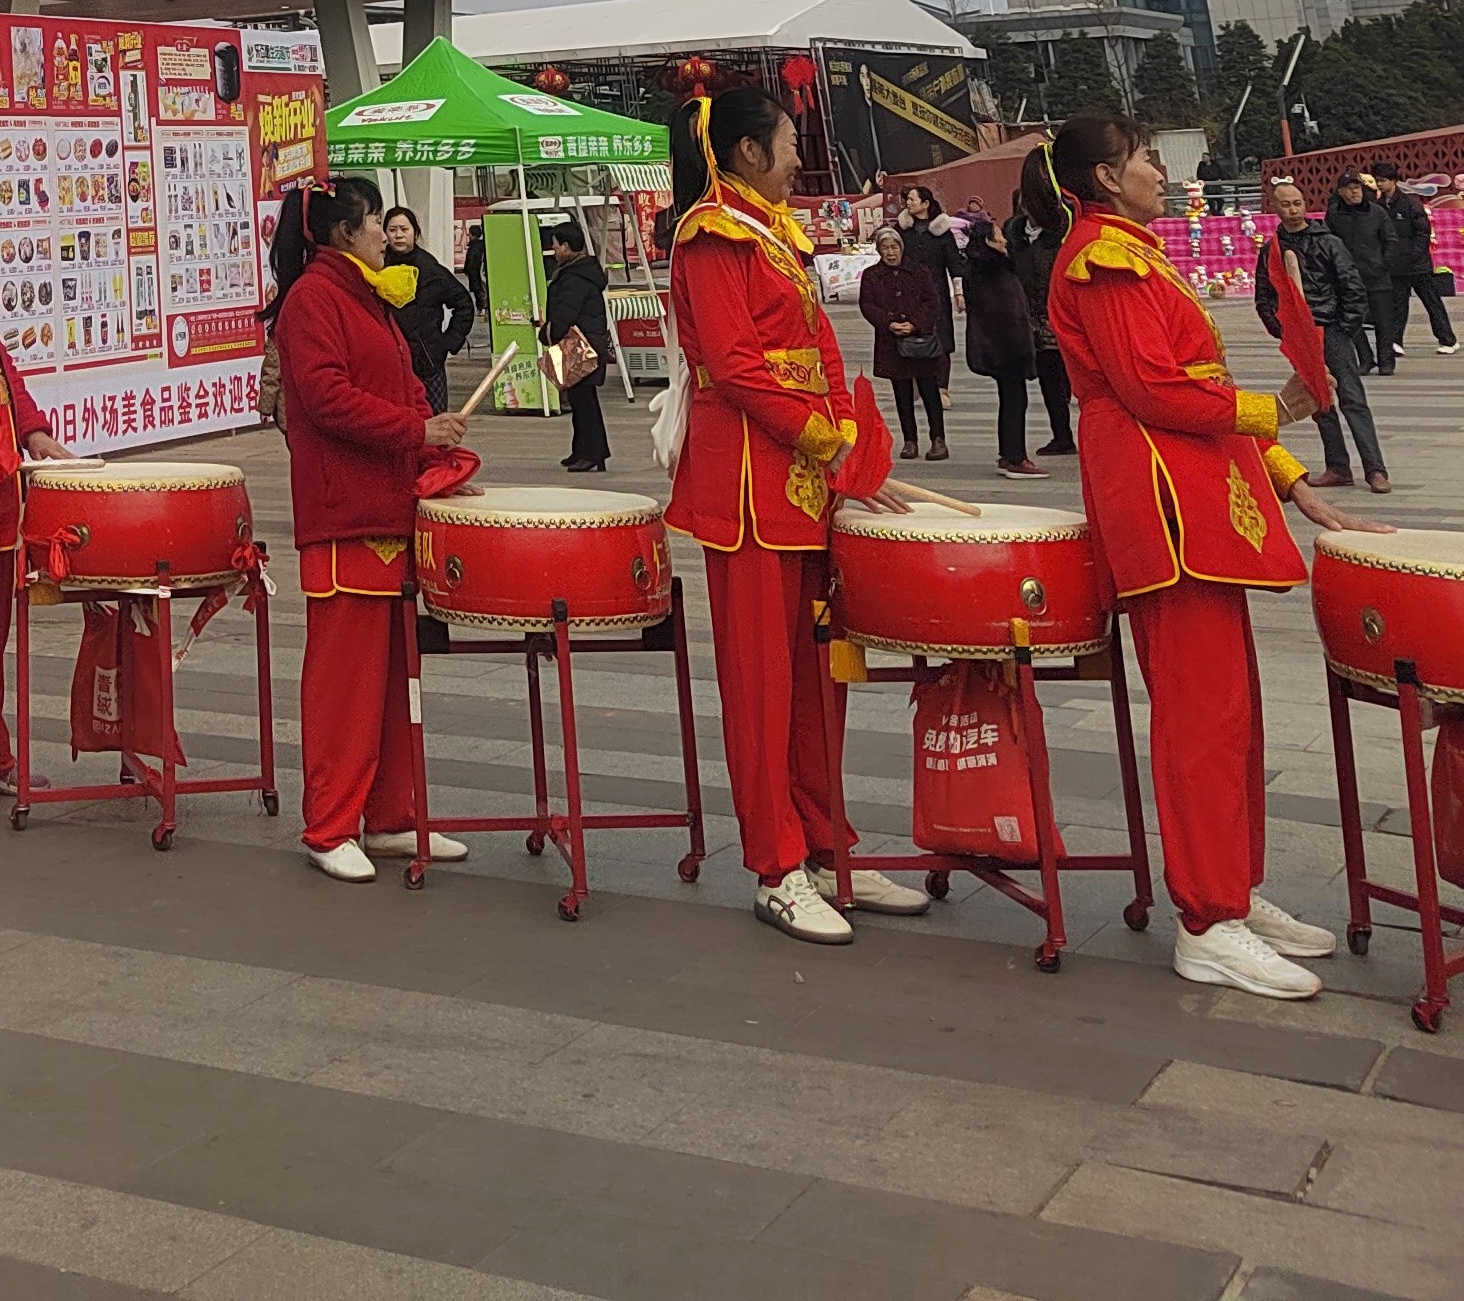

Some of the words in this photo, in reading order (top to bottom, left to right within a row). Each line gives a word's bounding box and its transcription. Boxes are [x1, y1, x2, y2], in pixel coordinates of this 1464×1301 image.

[259, 94, 316, 147] 焕新开业
[394, 139, 477, 162] 养乐多多
[39, 371, 260, 445] 0日外场美食品鉴会欢迎各
